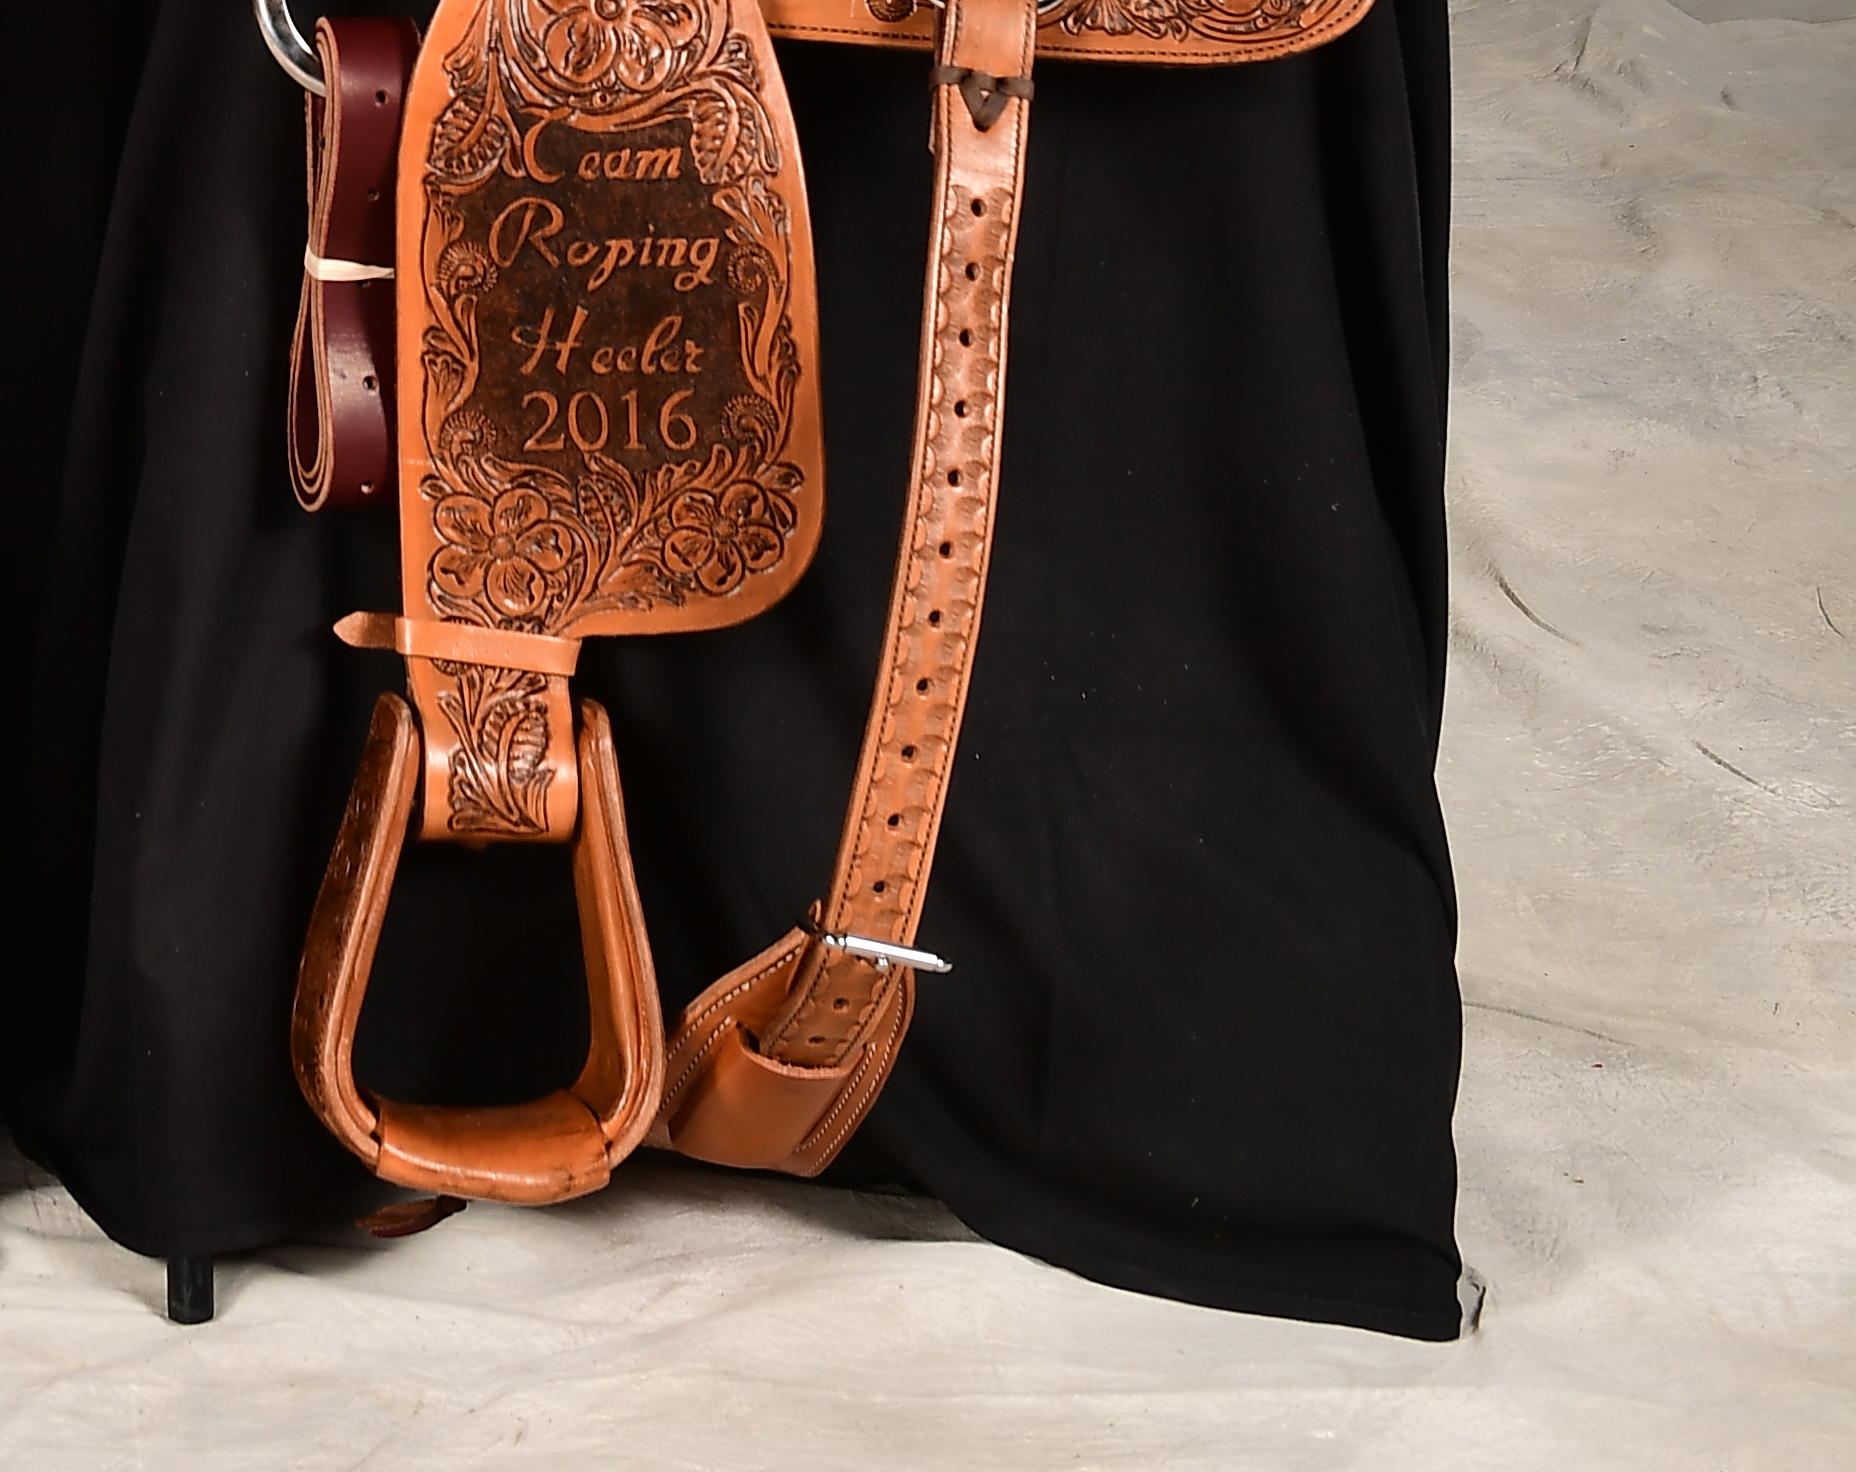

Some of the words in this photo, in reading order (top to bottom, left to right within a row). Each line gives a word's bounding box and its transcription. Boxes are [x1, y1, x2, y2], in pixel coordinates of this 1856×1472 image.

[488, 196, 721, 293] Roping
[509, 304, 706, 377] Heeler
[520, 388, 699, 452] 2016
